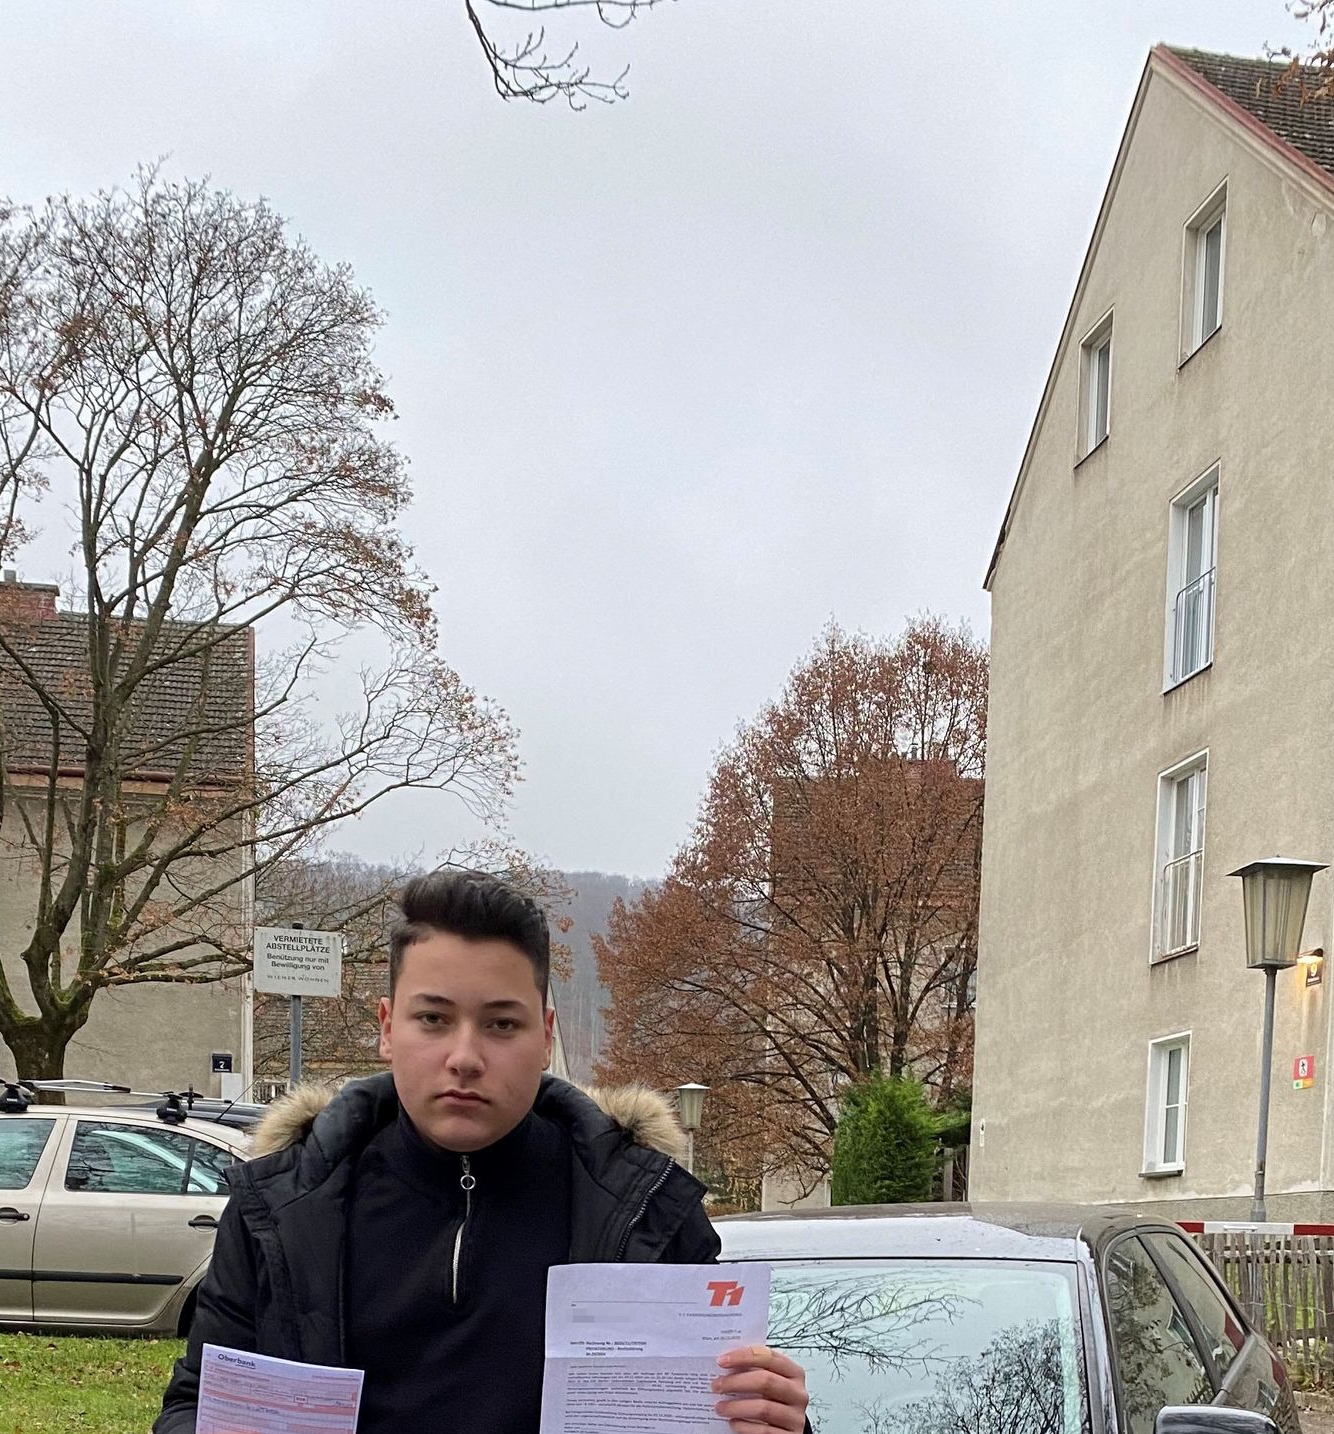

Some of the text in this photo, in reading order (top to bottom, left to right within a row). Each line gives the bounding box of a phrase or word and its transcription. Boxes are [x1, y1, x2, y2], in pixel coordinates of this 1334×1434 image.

[273, 934, 323, 945] VERMIETETE
[267, 953, 303, 962] Benützung
[271, 961, 310, 970] Bewilligung
[218, 1353, 256, 1368] Oberbank
